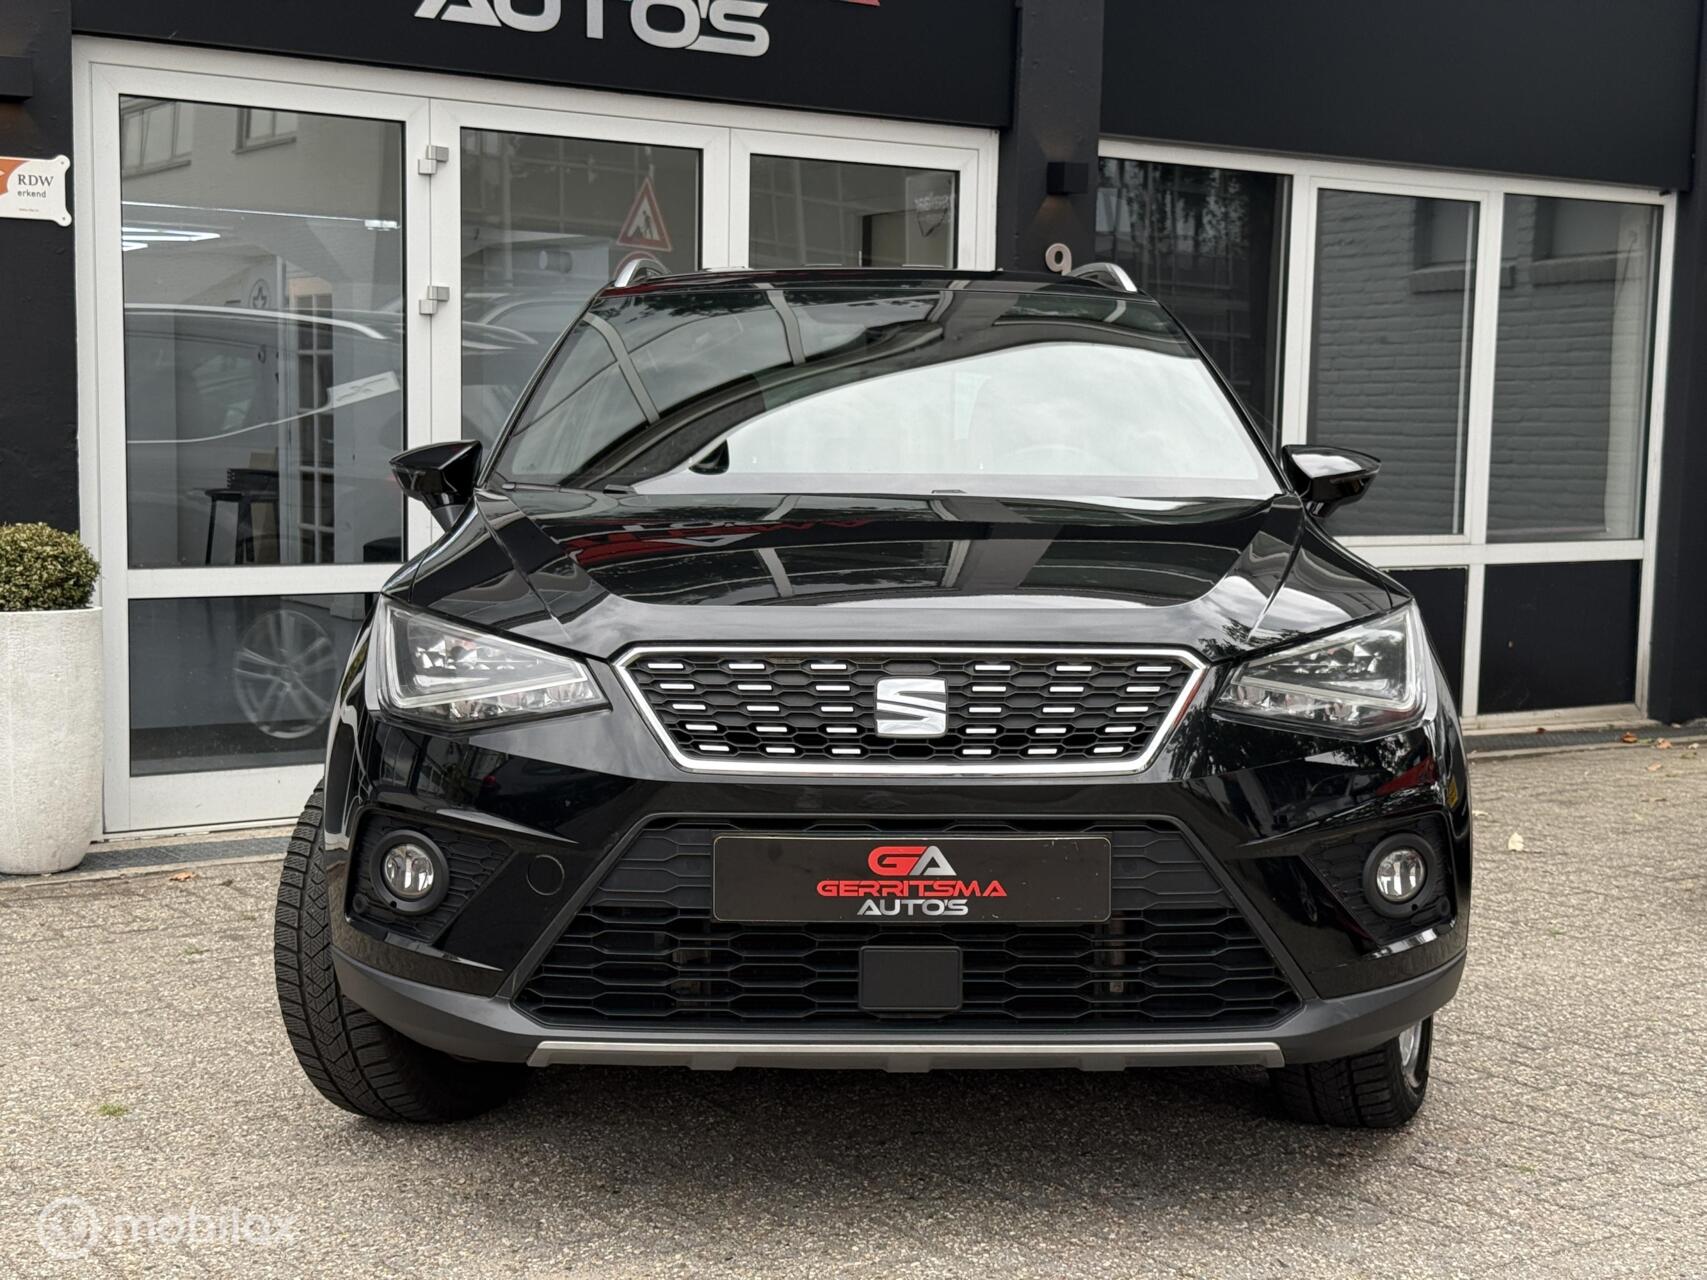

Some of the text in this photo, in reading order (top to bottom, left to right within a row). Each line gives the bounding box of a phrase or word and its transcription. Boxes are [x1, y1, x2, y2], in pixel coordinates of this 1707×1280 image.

[17, 174, 54, 187] RDW
[17, 189, 47, 198] erkend
[1045, 242, 1072, 276] 9
[867, 845, 957, 876] GA
[816, 880, 1008, 897] GERRITSMA
[856, 898, 969, 916] AUTO'S
